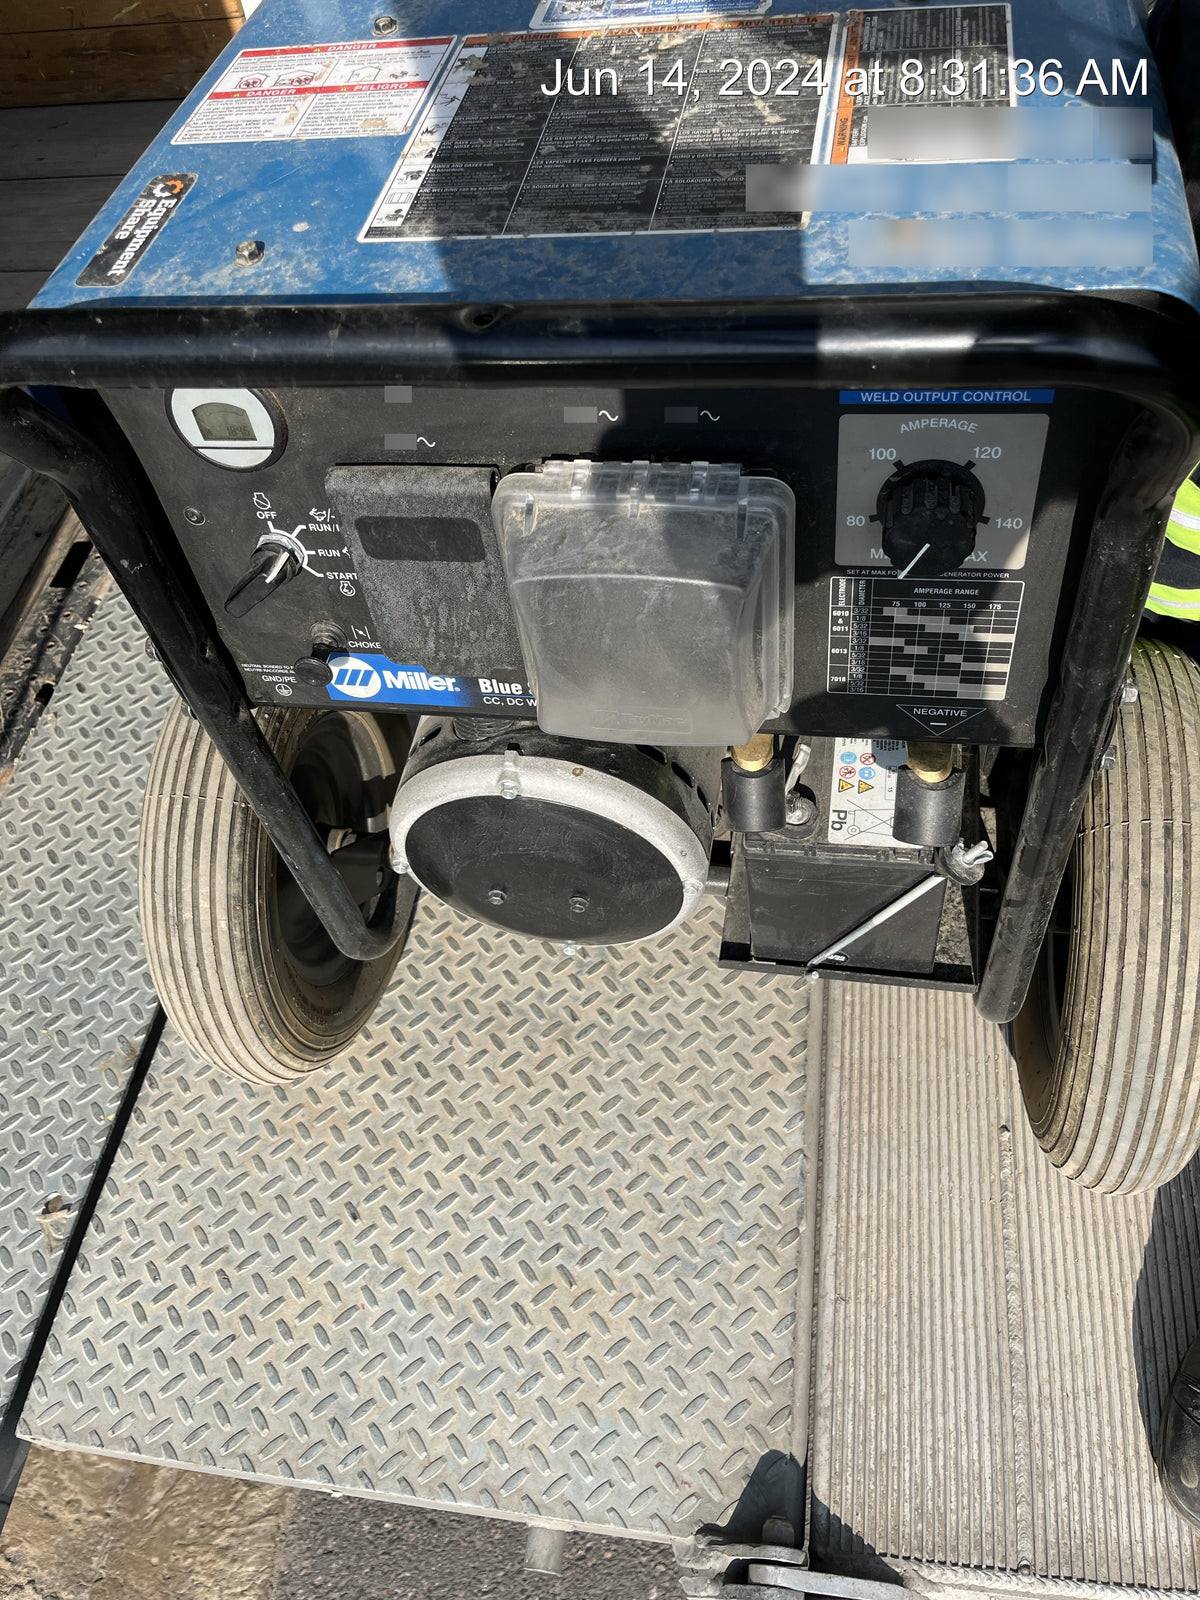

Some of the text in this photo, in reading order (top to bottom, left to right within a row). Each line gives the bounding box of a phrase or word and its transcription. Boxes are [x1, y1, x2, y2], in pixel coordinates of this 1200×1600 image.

[327, 43, 377, 52] DANGER
[354, 83, 408, 91] PELIGRO
[246, 89, 296, 97] DANGER
[837, 118, 848, 146] WARNING
[114, 199, 158, 240] Share
[107, 199, 178, 276] Equipment
[861, 391, 1031, 402] WELD OUTPUT CONTROL
[900, 418, 978, 434] AMPERAGE
[869, 448, 897, 460] 100
[973, 446, 1002, 459] 120
[256, 511, 277, 520] OFF
[846, 516, 865, 527] 80
[996, 518, 1023, 529] 140
[317, 549, 341, 557] RUN
[326, 572, 358, 580] START
[838, 578, 846, 606] ELECTRODE
[348, 640, 381, 650] CHOKE
[262, 675, 297, 683] GND/PE
[382, 670, 456, 692] Miller
[478, 678, 523, 695] Blue
[483, 696, 504, 706] CC,
[506, 698, 524, 706] DC
[913, 708, 968, 717] NEGATIVE
[831, 809, 847, 831] Pb
